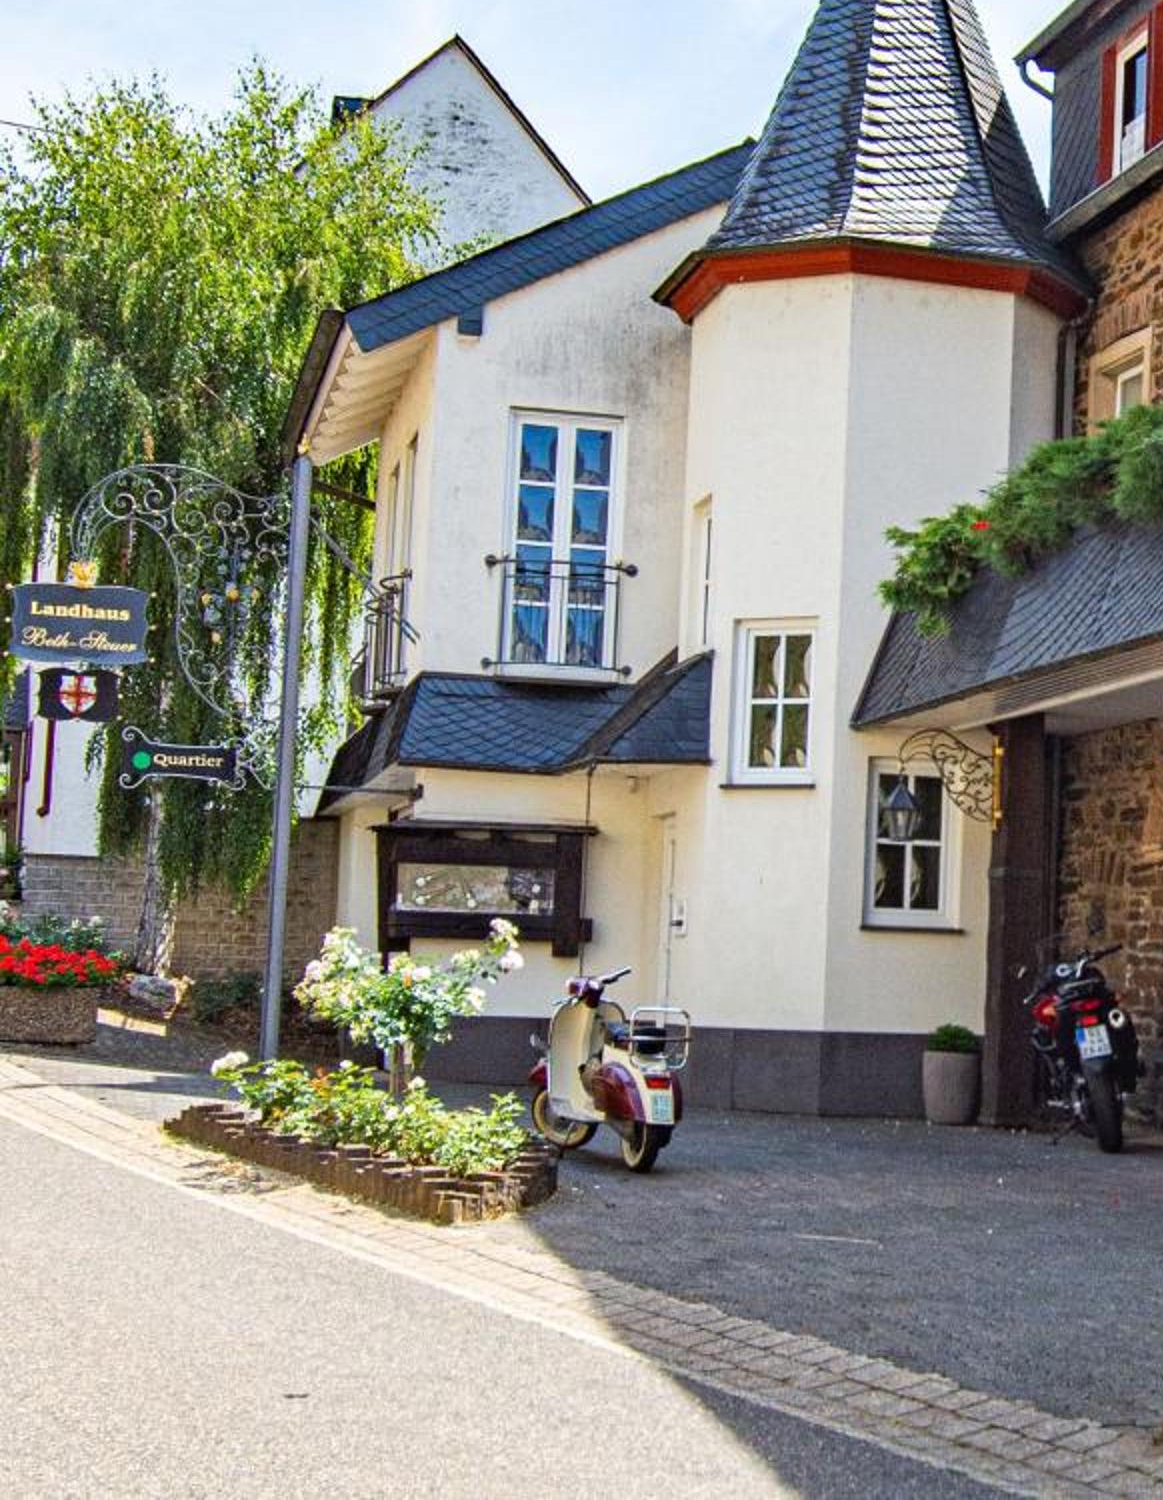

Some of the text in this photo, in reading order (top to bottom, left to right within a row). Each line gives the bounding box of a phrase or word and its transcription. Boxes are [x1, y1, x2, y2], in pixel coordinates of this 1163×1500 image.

[31, 602, 130, 621] Landhaus
[21, 626, 136, 653] Beth-Steuer
[153, 752, 225, 768] Quartier
